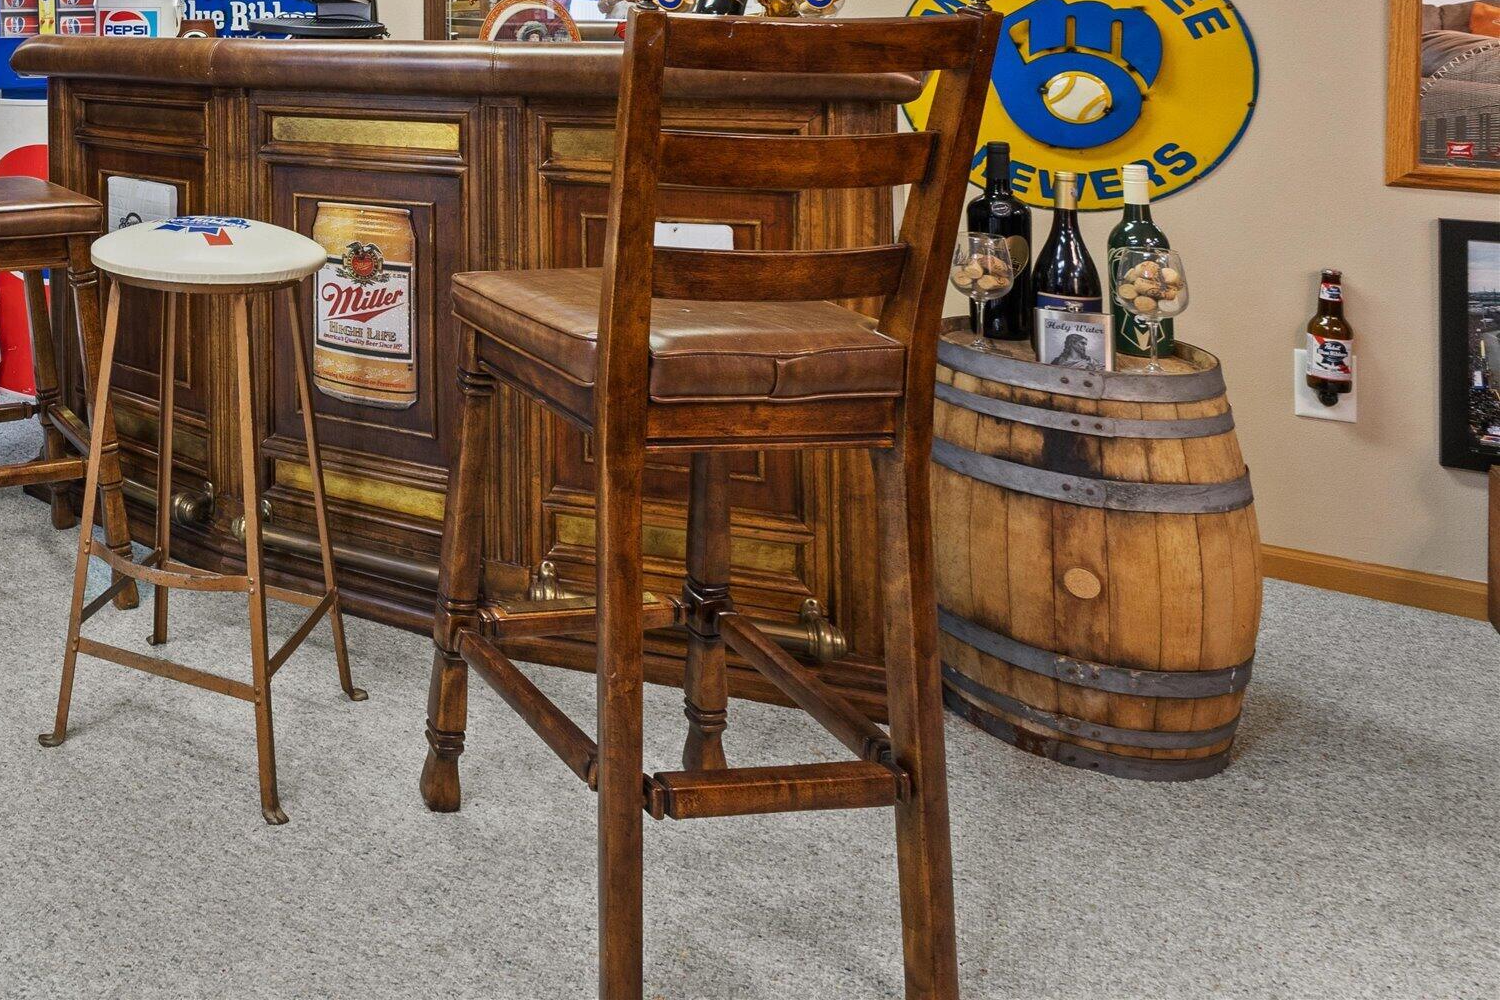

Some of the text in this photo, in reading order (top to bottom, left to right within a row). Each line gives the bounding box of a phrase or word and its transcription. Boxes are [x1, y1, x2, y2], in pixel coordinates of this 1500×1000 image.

[105, 24, 148, 36] PEPSI
[971, 143, 1198, 201] EWERS
[321, 281, 404, 317] Miller
[329, 321, 397, 342] HIGH LIFE
[1045, 320, 1104, 335] Holy Water
